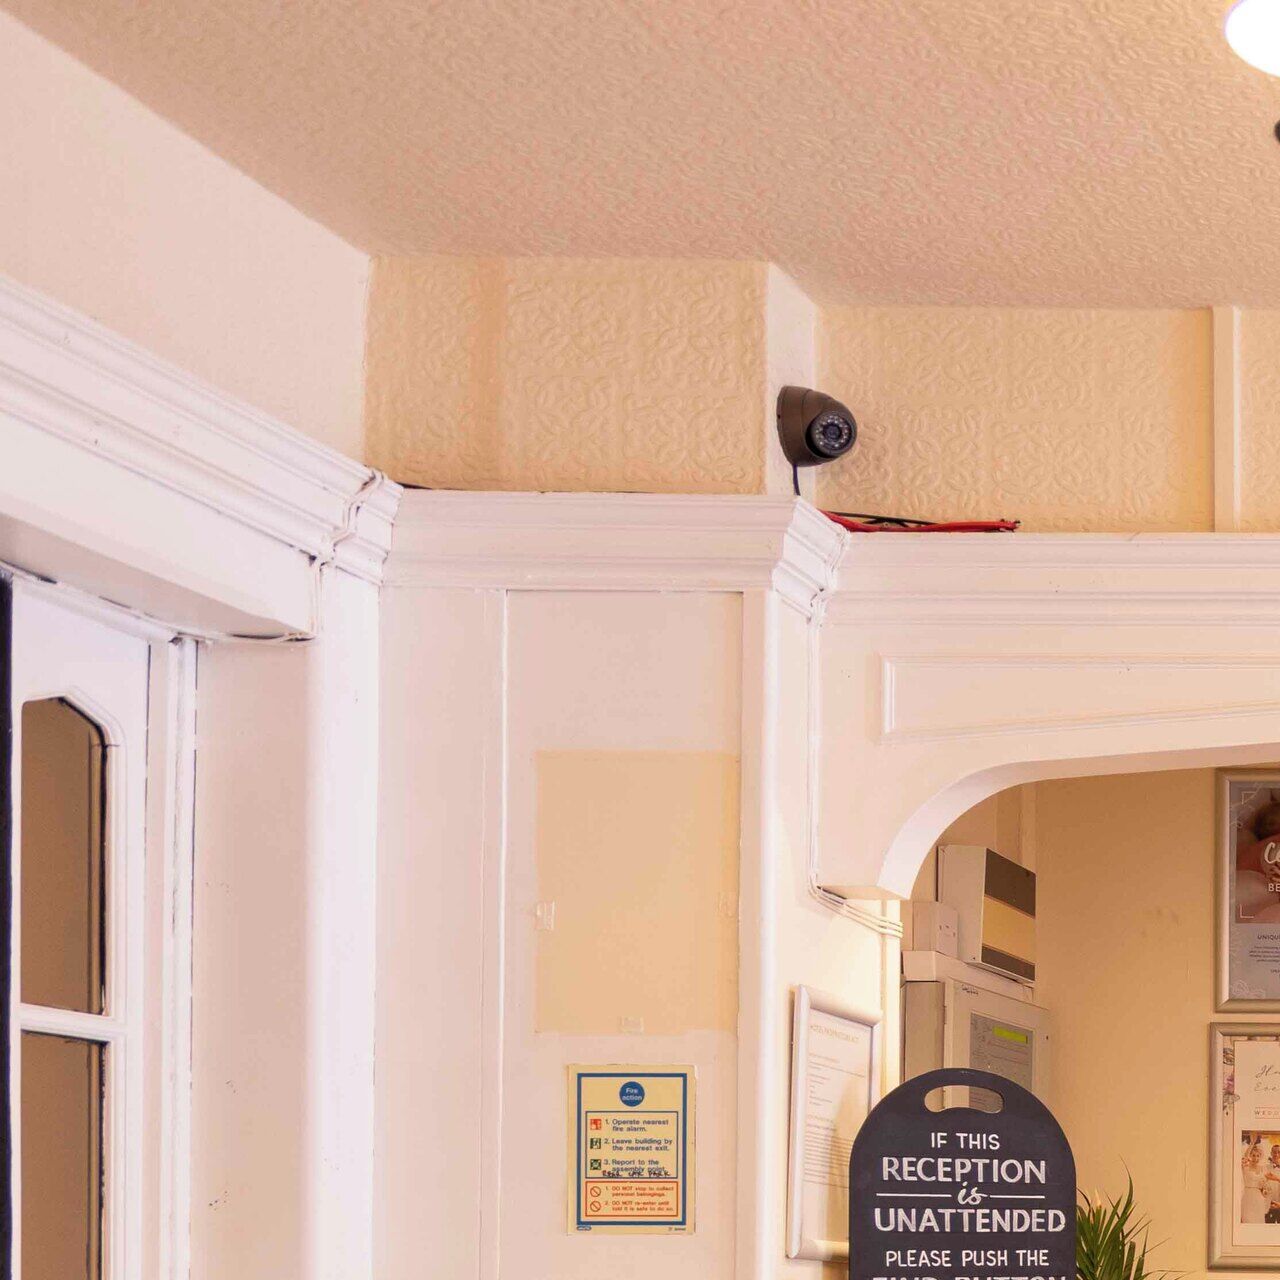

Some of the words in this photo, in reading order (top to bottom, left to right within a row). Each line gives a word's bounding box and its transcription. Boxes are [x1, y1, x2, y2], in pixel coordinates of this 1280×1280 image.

[931, 1133, 947, 1149] IF
[956, 1133, 1000, 1149] THIS
[882, 1156, 1046, 1184] RECEPTION
[957, 1181, 988, 1205] is
[874, 1208, 1066, 1232] UNATTENDED
[886, 1250, 951, 1267] PLEASE
[962, 1250, 1008, 1267] PUSH
[1016, 1250, 1049, 1267] THE
